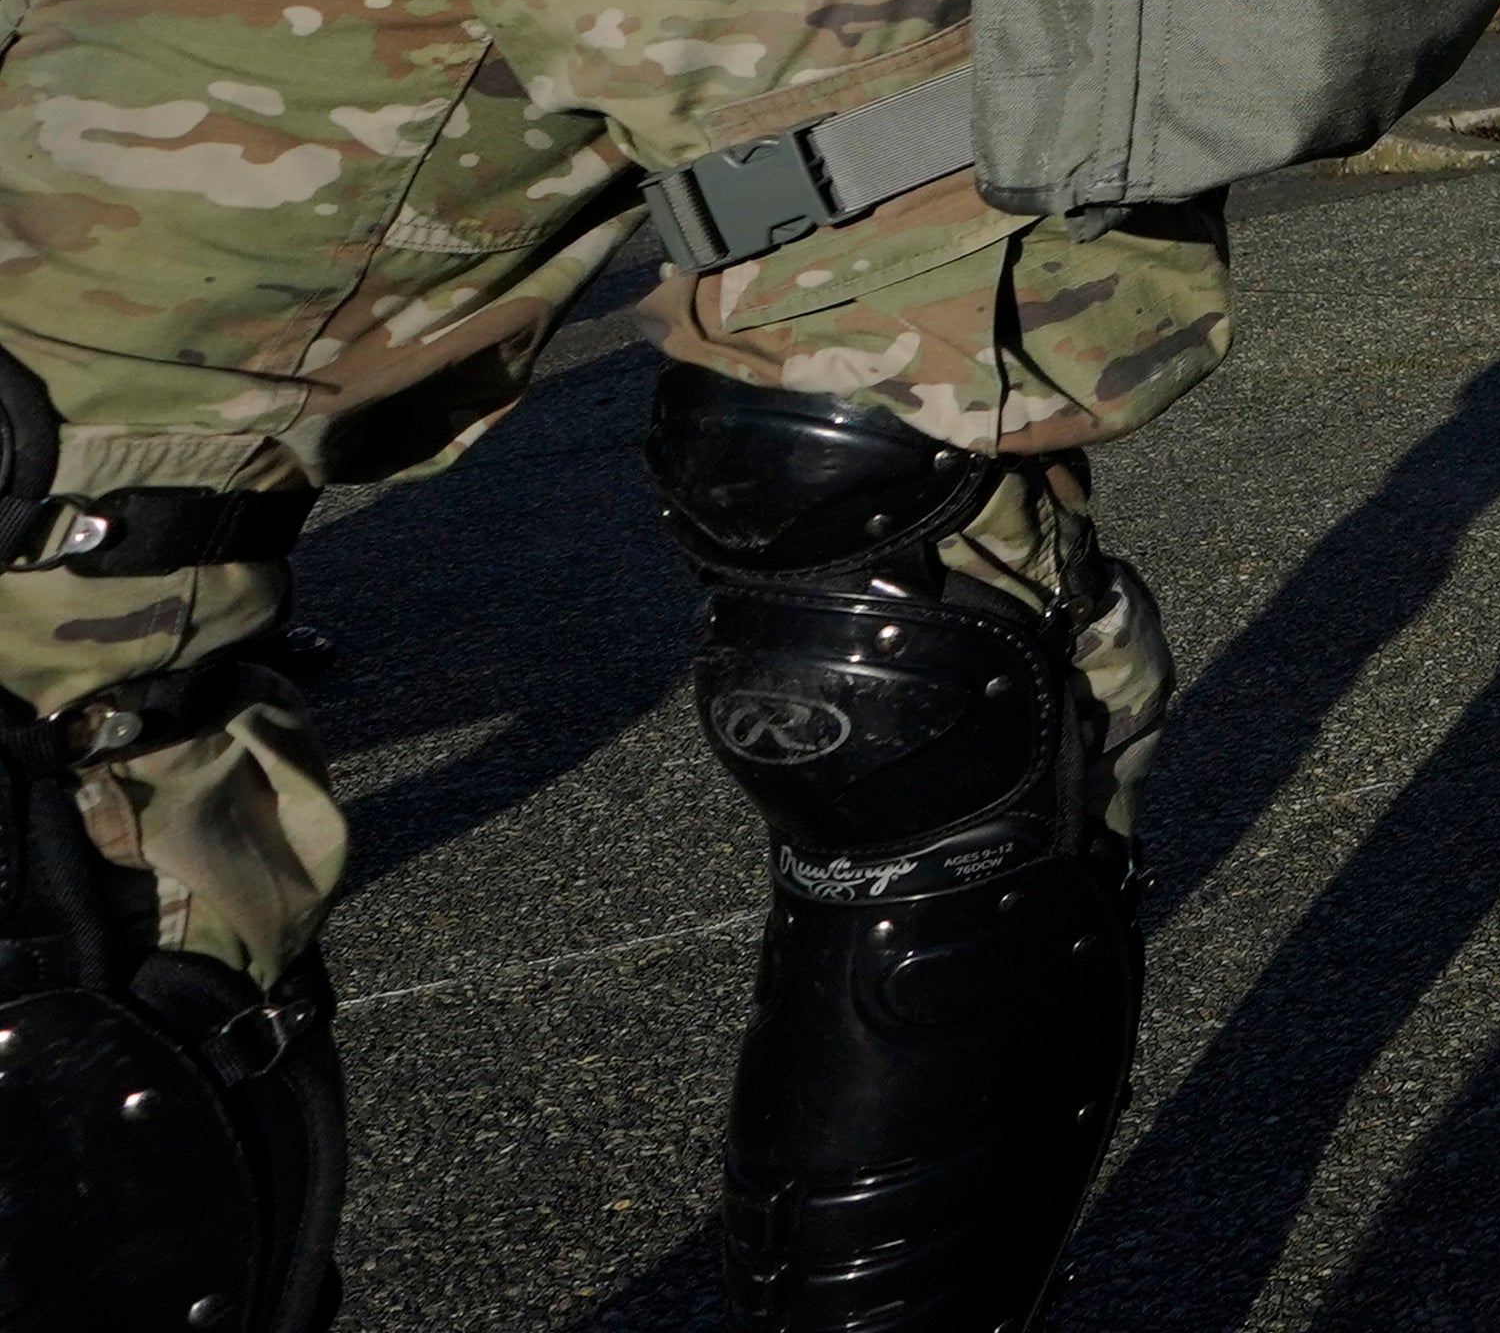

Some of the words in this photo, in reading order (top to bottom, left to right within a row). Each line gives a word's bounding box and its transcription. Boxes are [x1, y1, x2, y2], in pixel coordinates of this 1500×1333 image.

[723, 702, 830, 752] R
[779, 845, 918, 896] Rawlings
[943, 851, 980, 868] AGES
[981, 842, 1014, 859] 9-12
[955, 856, 1004, 877] 76DCW
